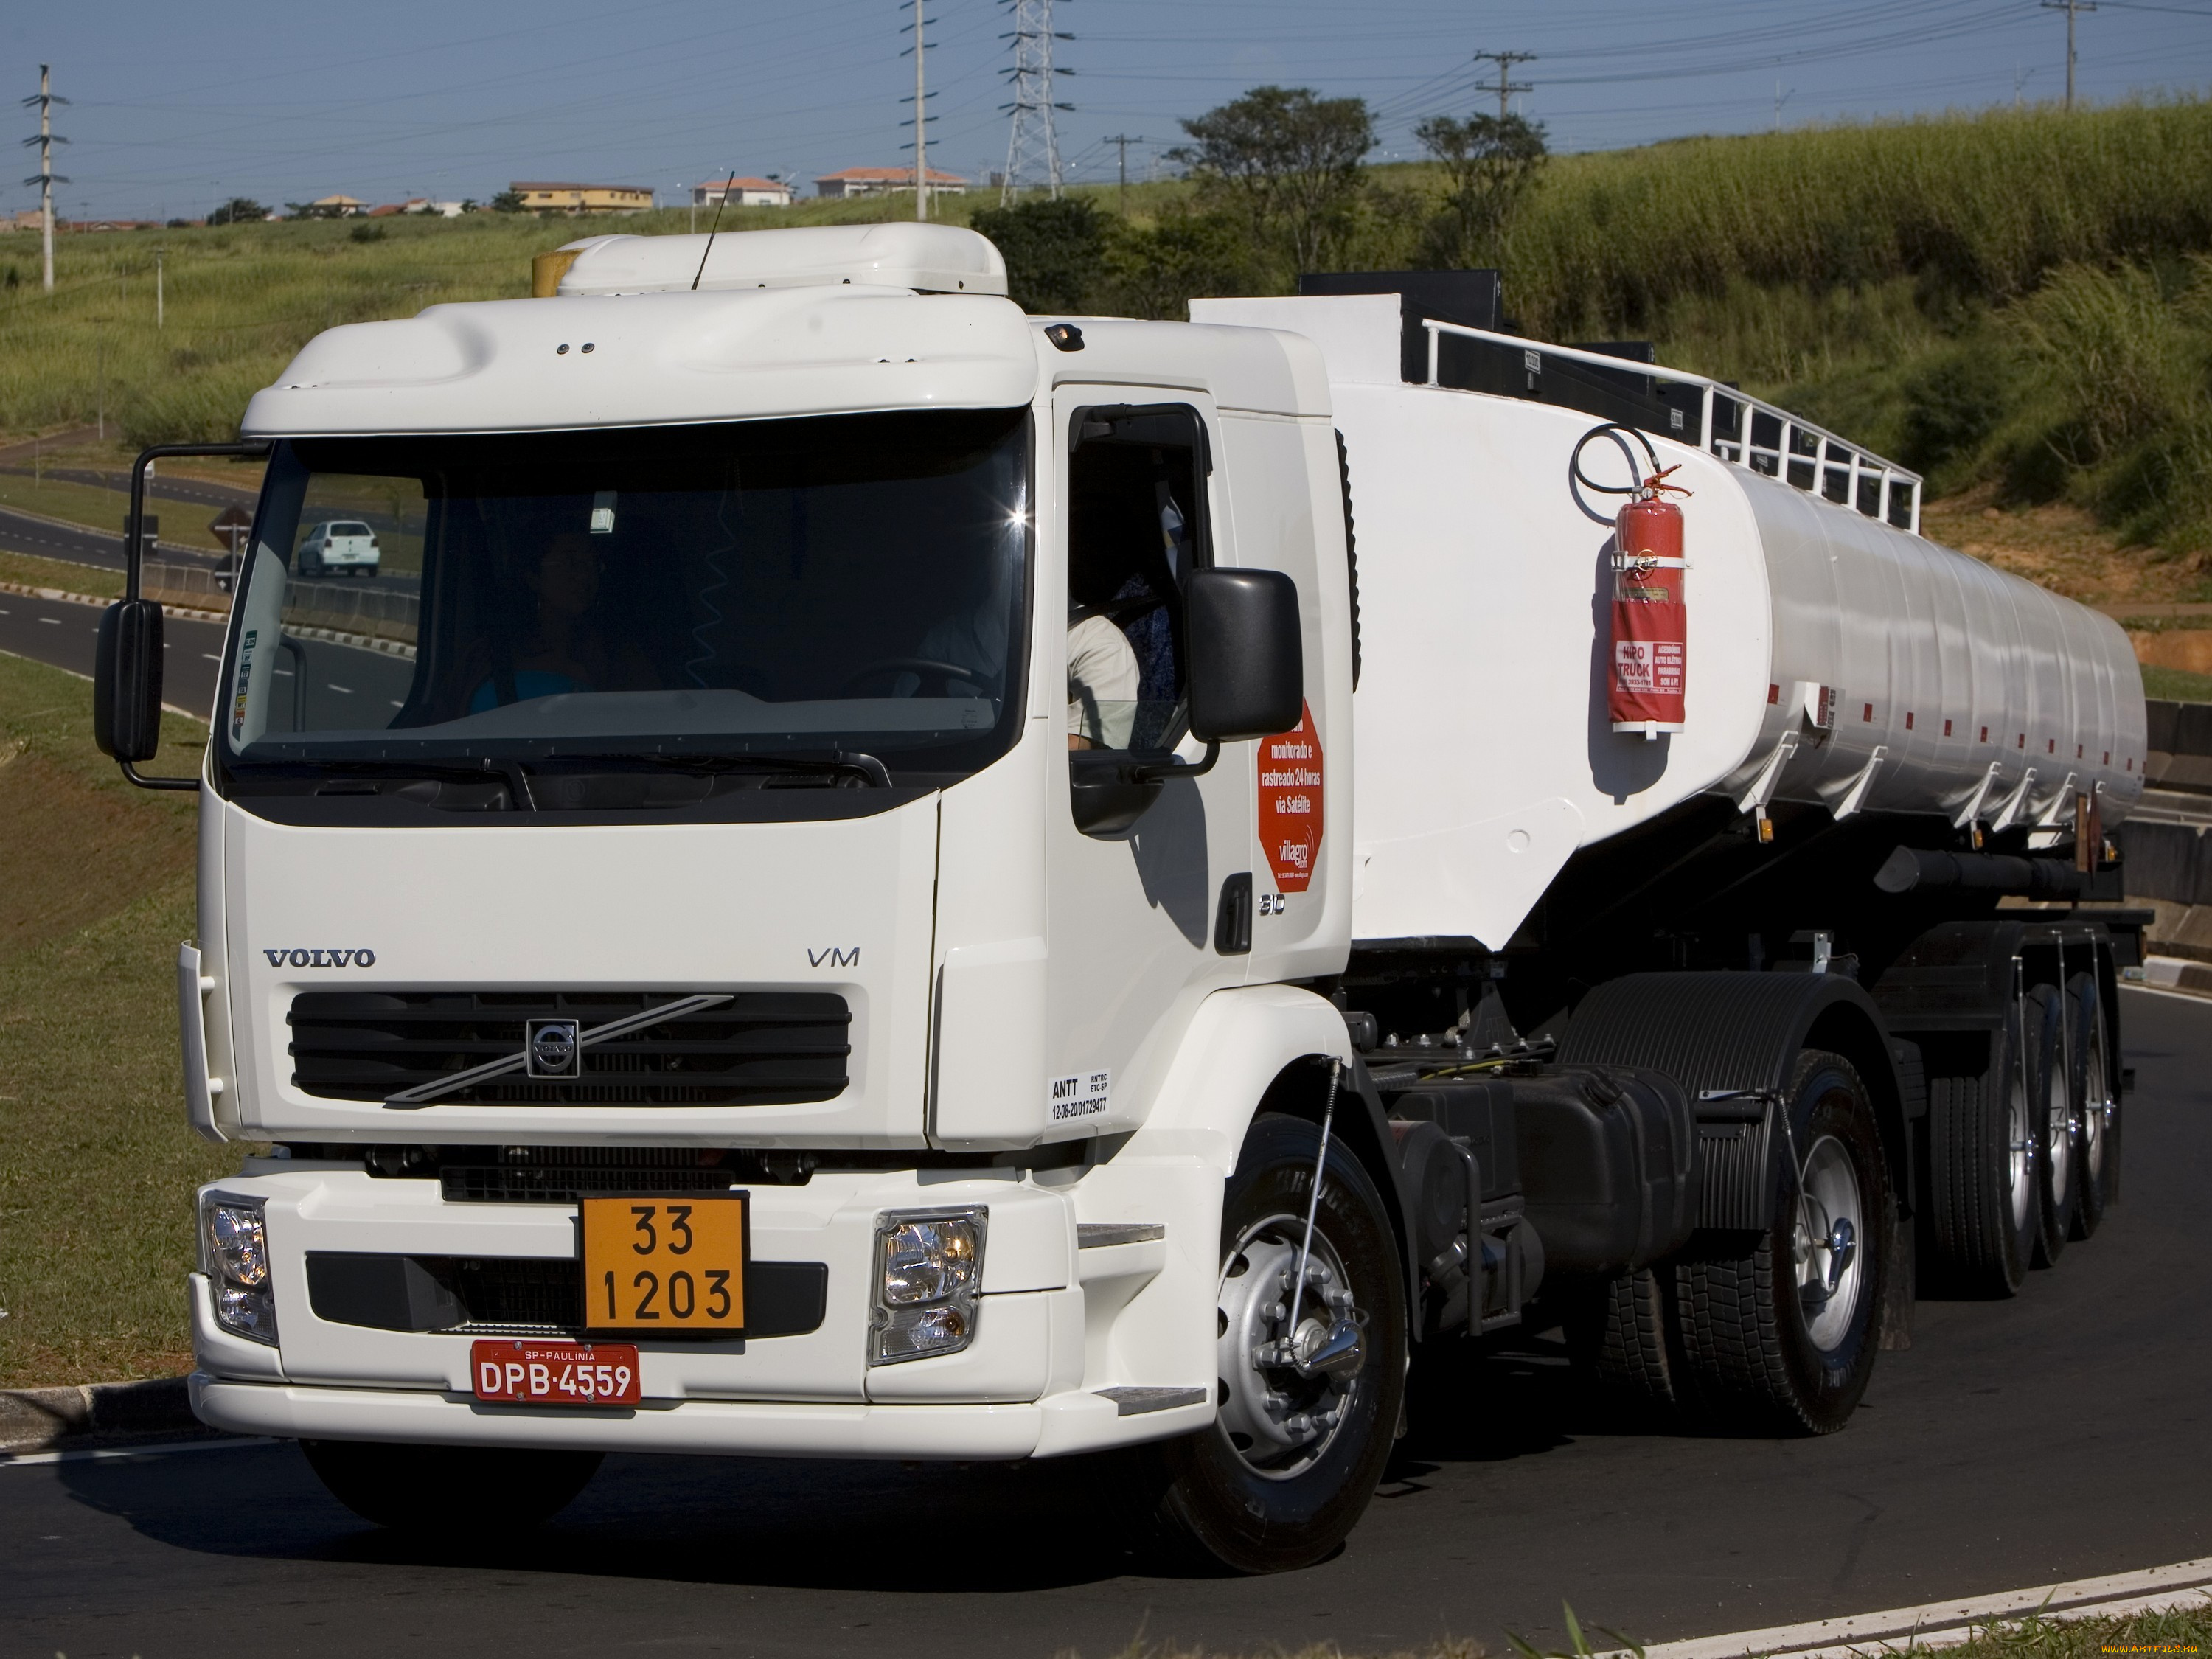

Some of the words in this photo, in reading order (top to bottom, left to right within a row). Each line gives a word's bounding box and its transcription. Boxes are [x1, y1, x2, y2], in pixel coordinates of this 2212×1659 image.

[1618, 663, 1650, 677] TRUCK
[1271, 740, 1307, 759] monitorado
[1308, 745, 1312, 759] e
[1262, 768, 1294, 787] rastreado
[1295, 768, 1304, 786] 24
[1304, 768, 1321, 786] horas
[1276, 796, 1286, 813] via
[1287, 794, 1310, 813] Satélite
[1279, 840, 1307, 866] villagro
[263, 948, 376, 967] VOLVO
[807, 947, 860, 967] VM
[1091, 1074, 1107, 1082] RNTRC
[1091, 1083, 1107, 1092] ETC-SP
[1053, 1078, 1078, 1099] ANTT
[630, 1206, 693, 1255] 33
[605, 1270, 731, 1320] 1203
